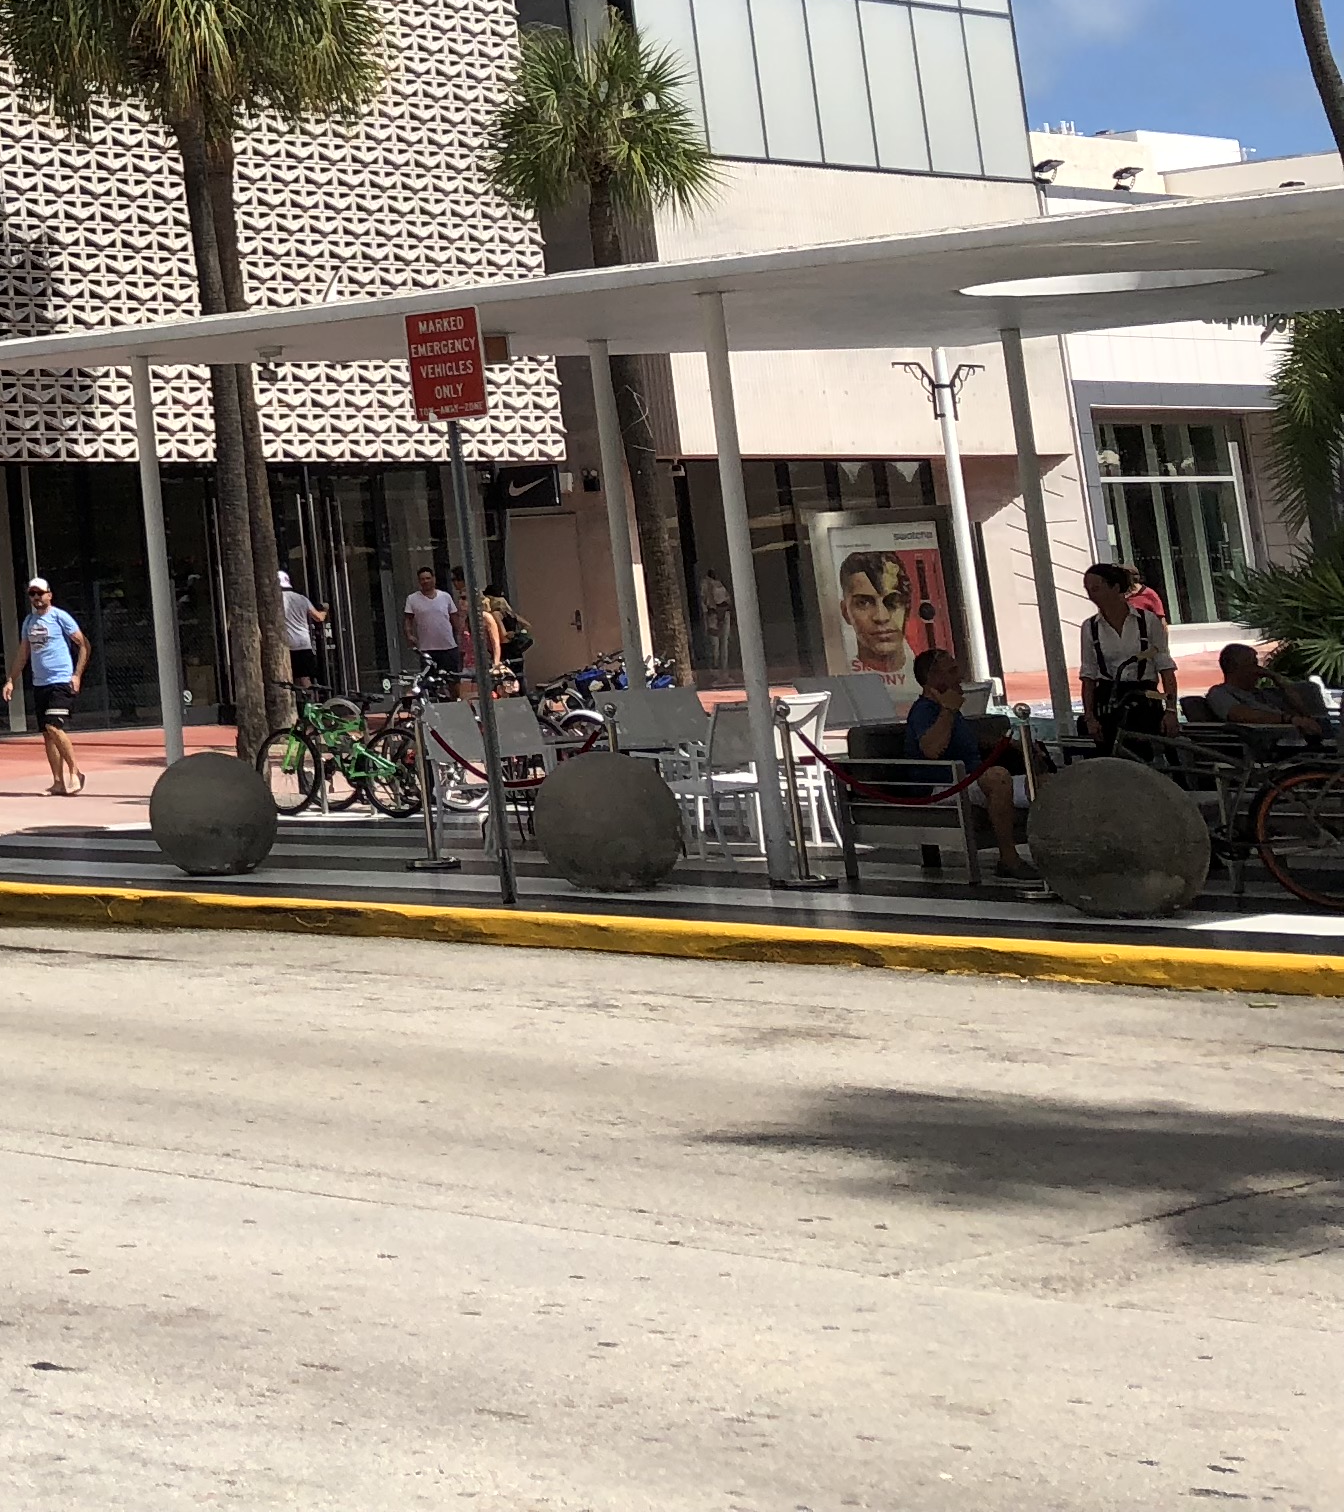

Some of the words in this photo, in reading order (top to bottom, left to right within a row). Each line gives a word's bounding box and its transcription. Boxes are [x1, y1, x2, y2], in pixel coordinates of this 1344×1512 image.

[418, 316, 464, 335] MARKED
[410, 336, 476, 358] EMERGENCY
[419, 359, 474, 379] VEHICLES
[434, 383, 464, 400] ONLY
